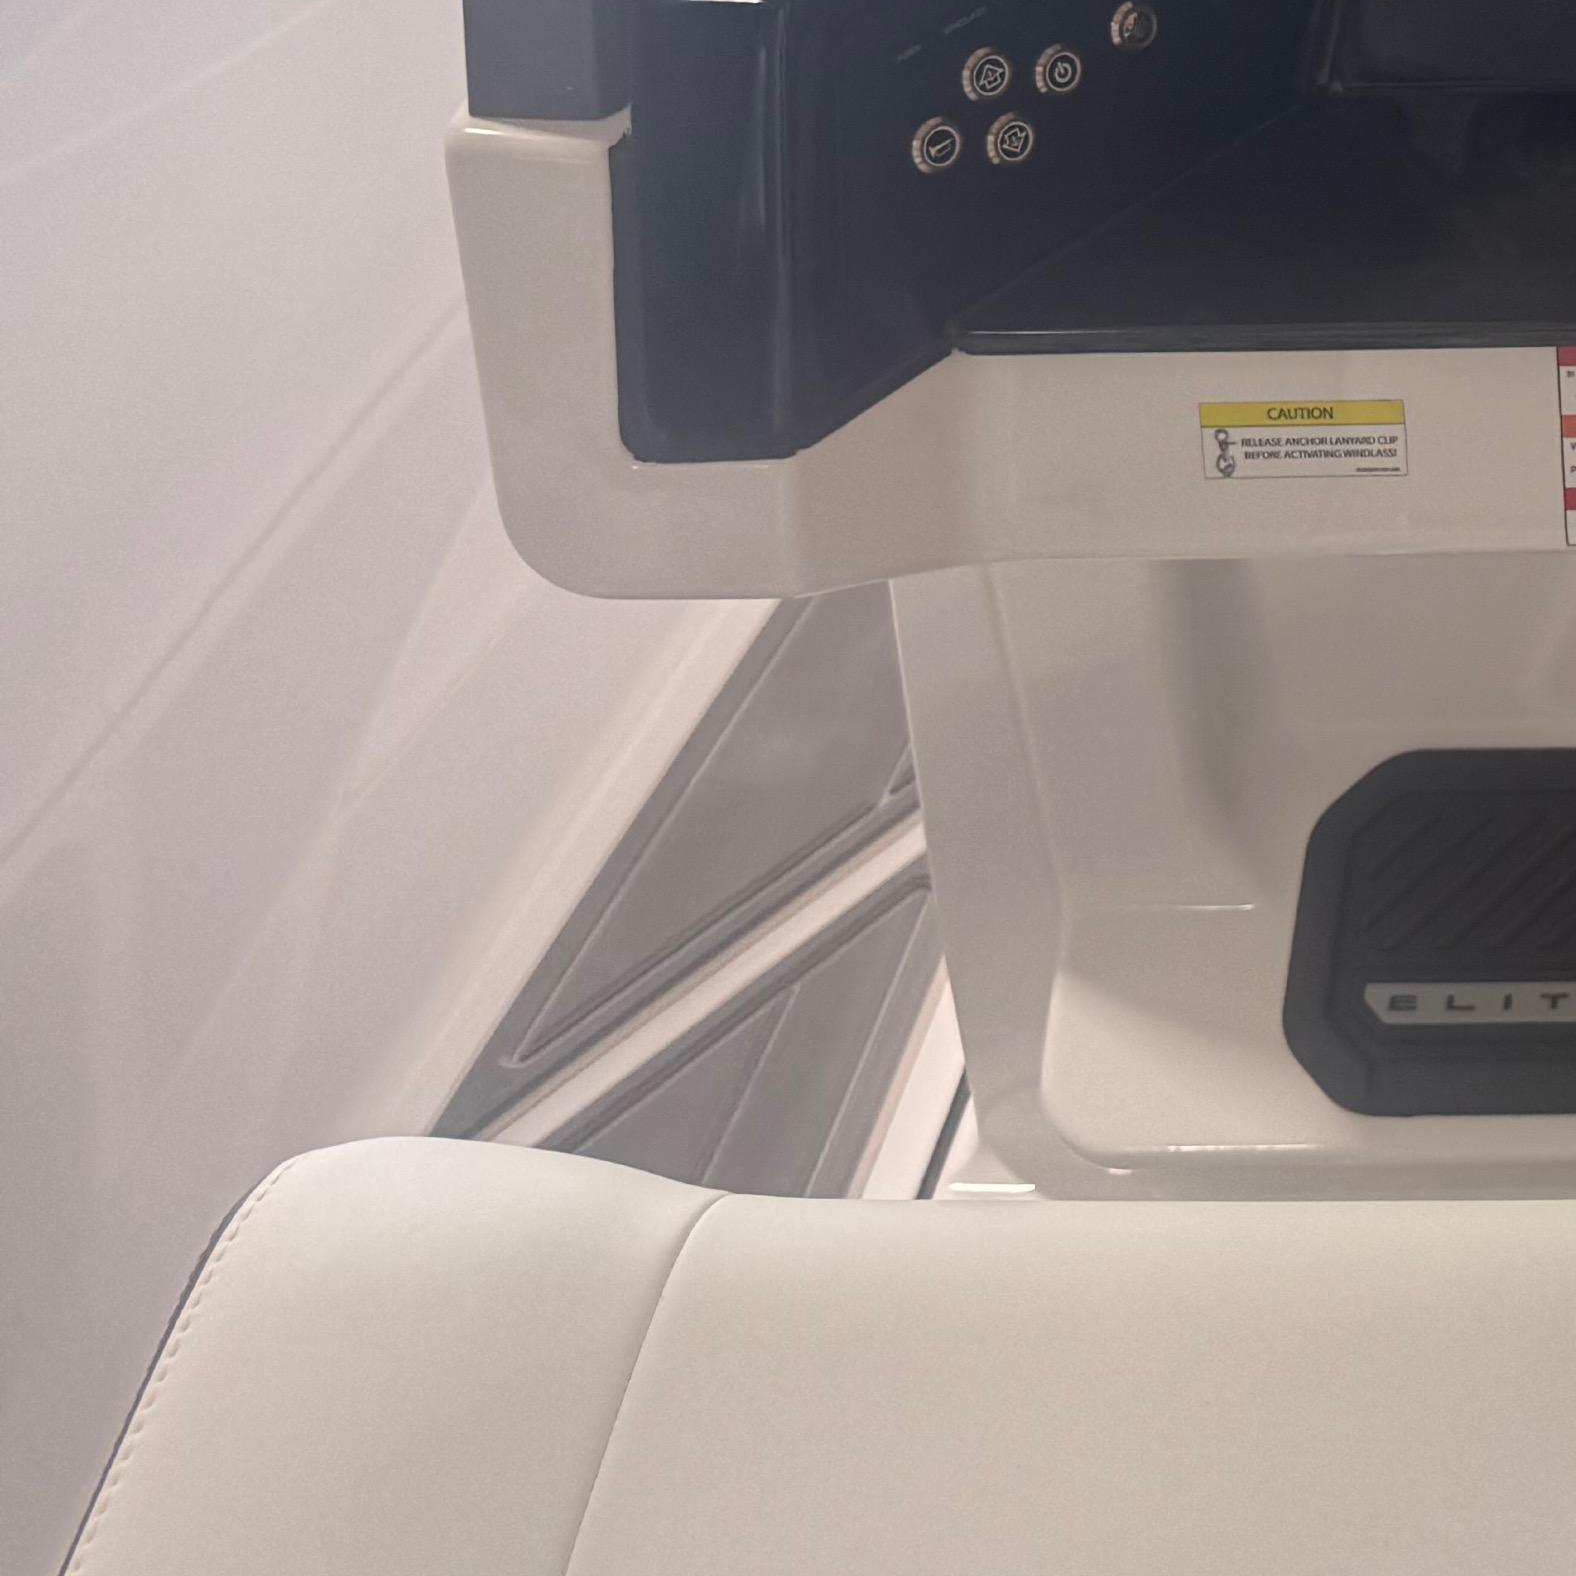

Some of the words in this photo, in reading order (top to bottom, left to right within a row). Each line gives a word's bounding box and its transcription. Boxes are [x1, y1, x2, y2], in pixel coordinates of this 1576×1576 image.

[1267, 407, 1334, 420] CAUTION
[1241, 438, 1283, 447] RELEASE
[1285, 437, 1328, 447] ANCHOR
[1329, 436, 1375, 446] LANYARD
[1377, 436, 1398, 444] CLIP
[1244, 451, 1282, 460] BEFORE
[1284, 449, 1342, 459] ACTIVATING
[1343, 448, 1398, 458] WINDLASS!
